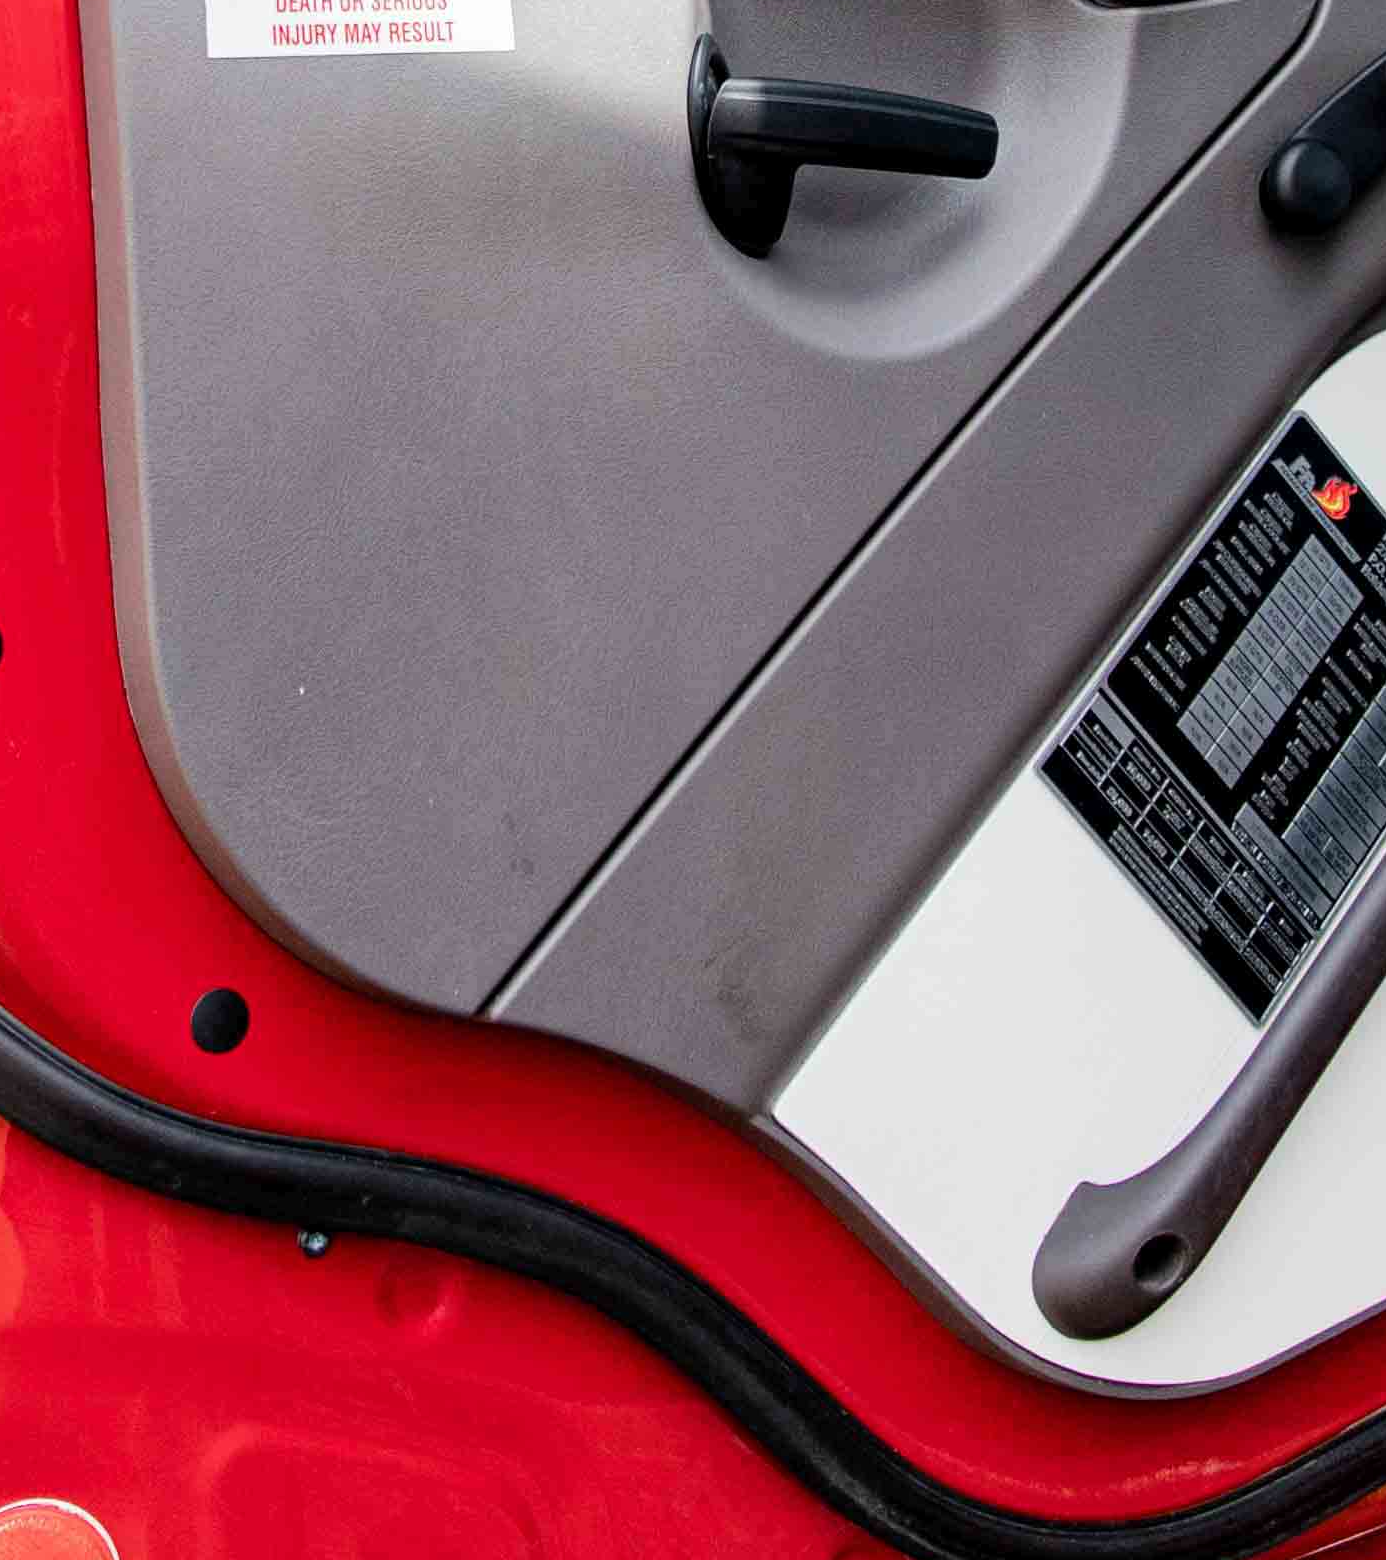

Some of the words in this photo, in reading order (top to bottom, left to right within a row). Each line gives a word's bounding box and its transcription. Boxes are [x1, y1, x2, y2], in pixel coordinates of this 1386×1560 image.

[272, 24, 337, 46] INJURY
[345, 23, 382, 44] MAY
[389, 21, 454, 42] RESULT
